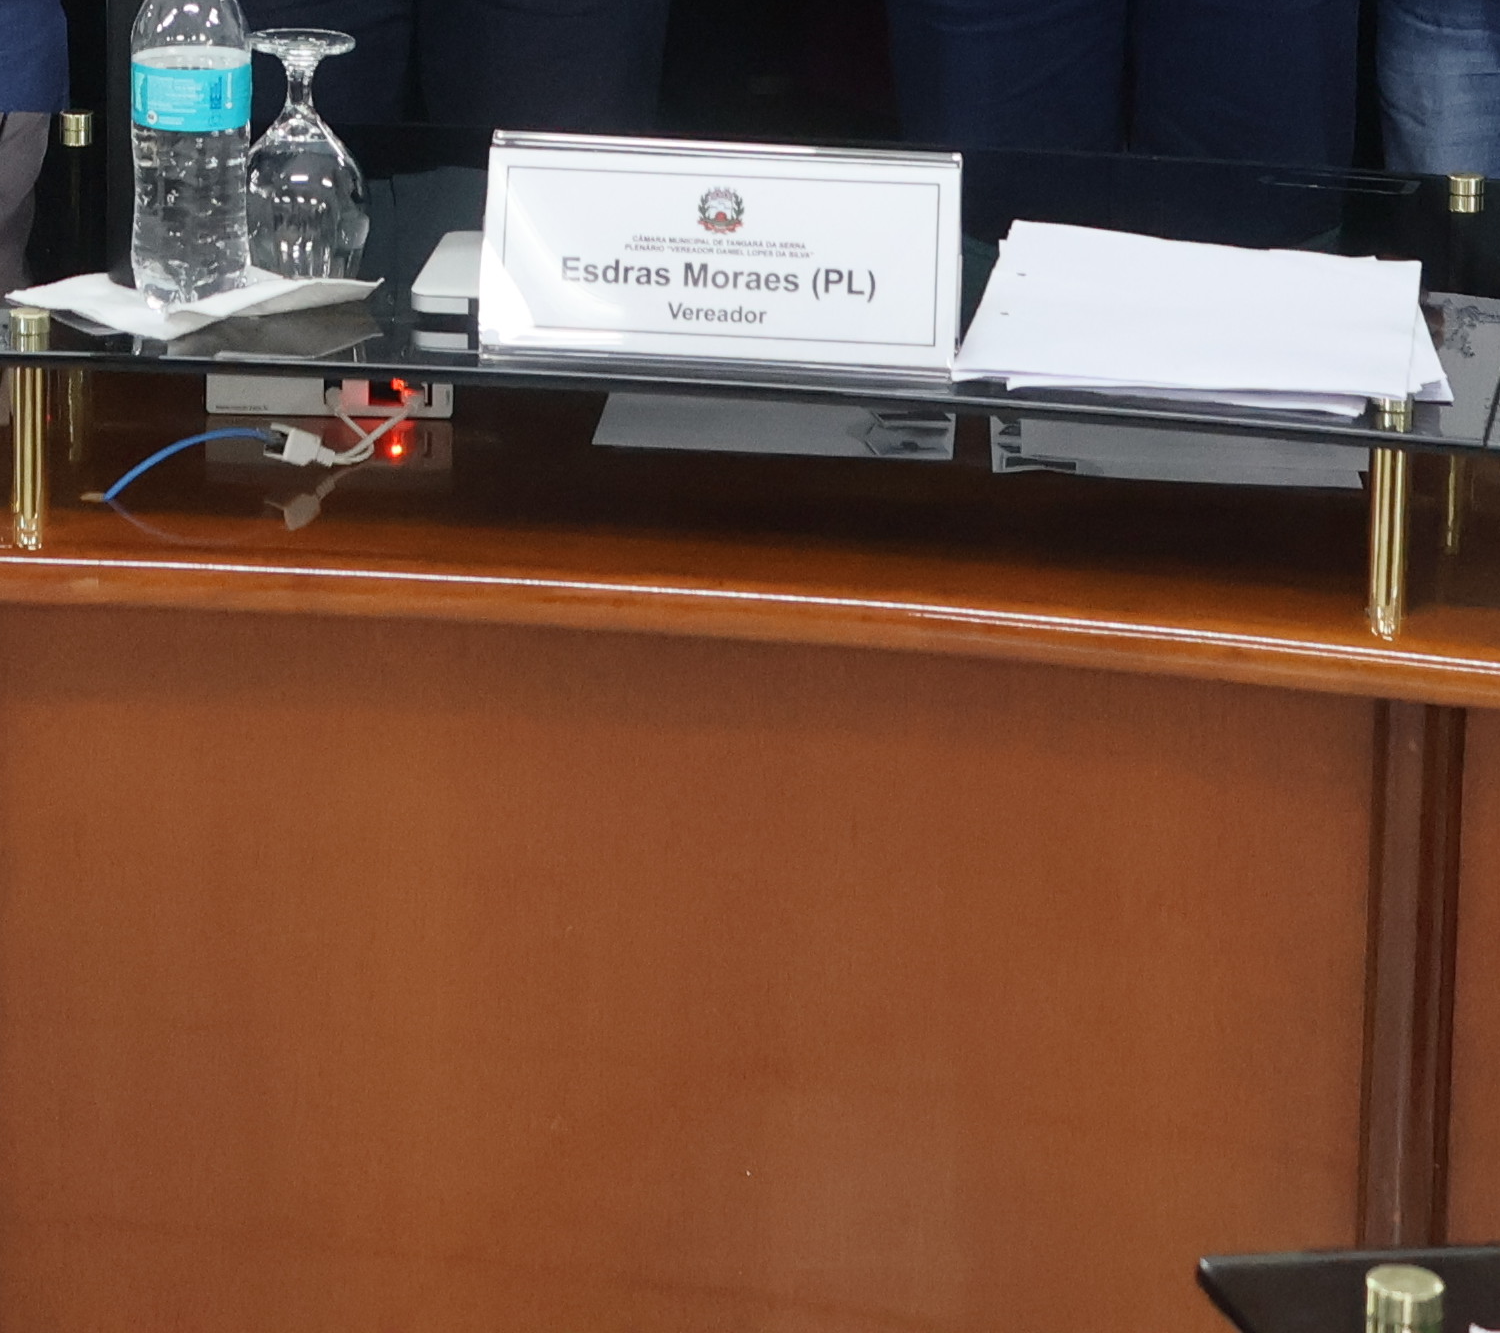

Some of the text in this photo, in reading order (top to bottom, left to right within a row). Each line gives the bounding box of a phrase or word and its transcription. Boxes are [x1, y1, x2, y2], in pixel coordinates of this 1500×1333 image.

[561, 256, 877, 303] Esdras Moraes (PL)
[667, 302, 768, 326] Vereador
